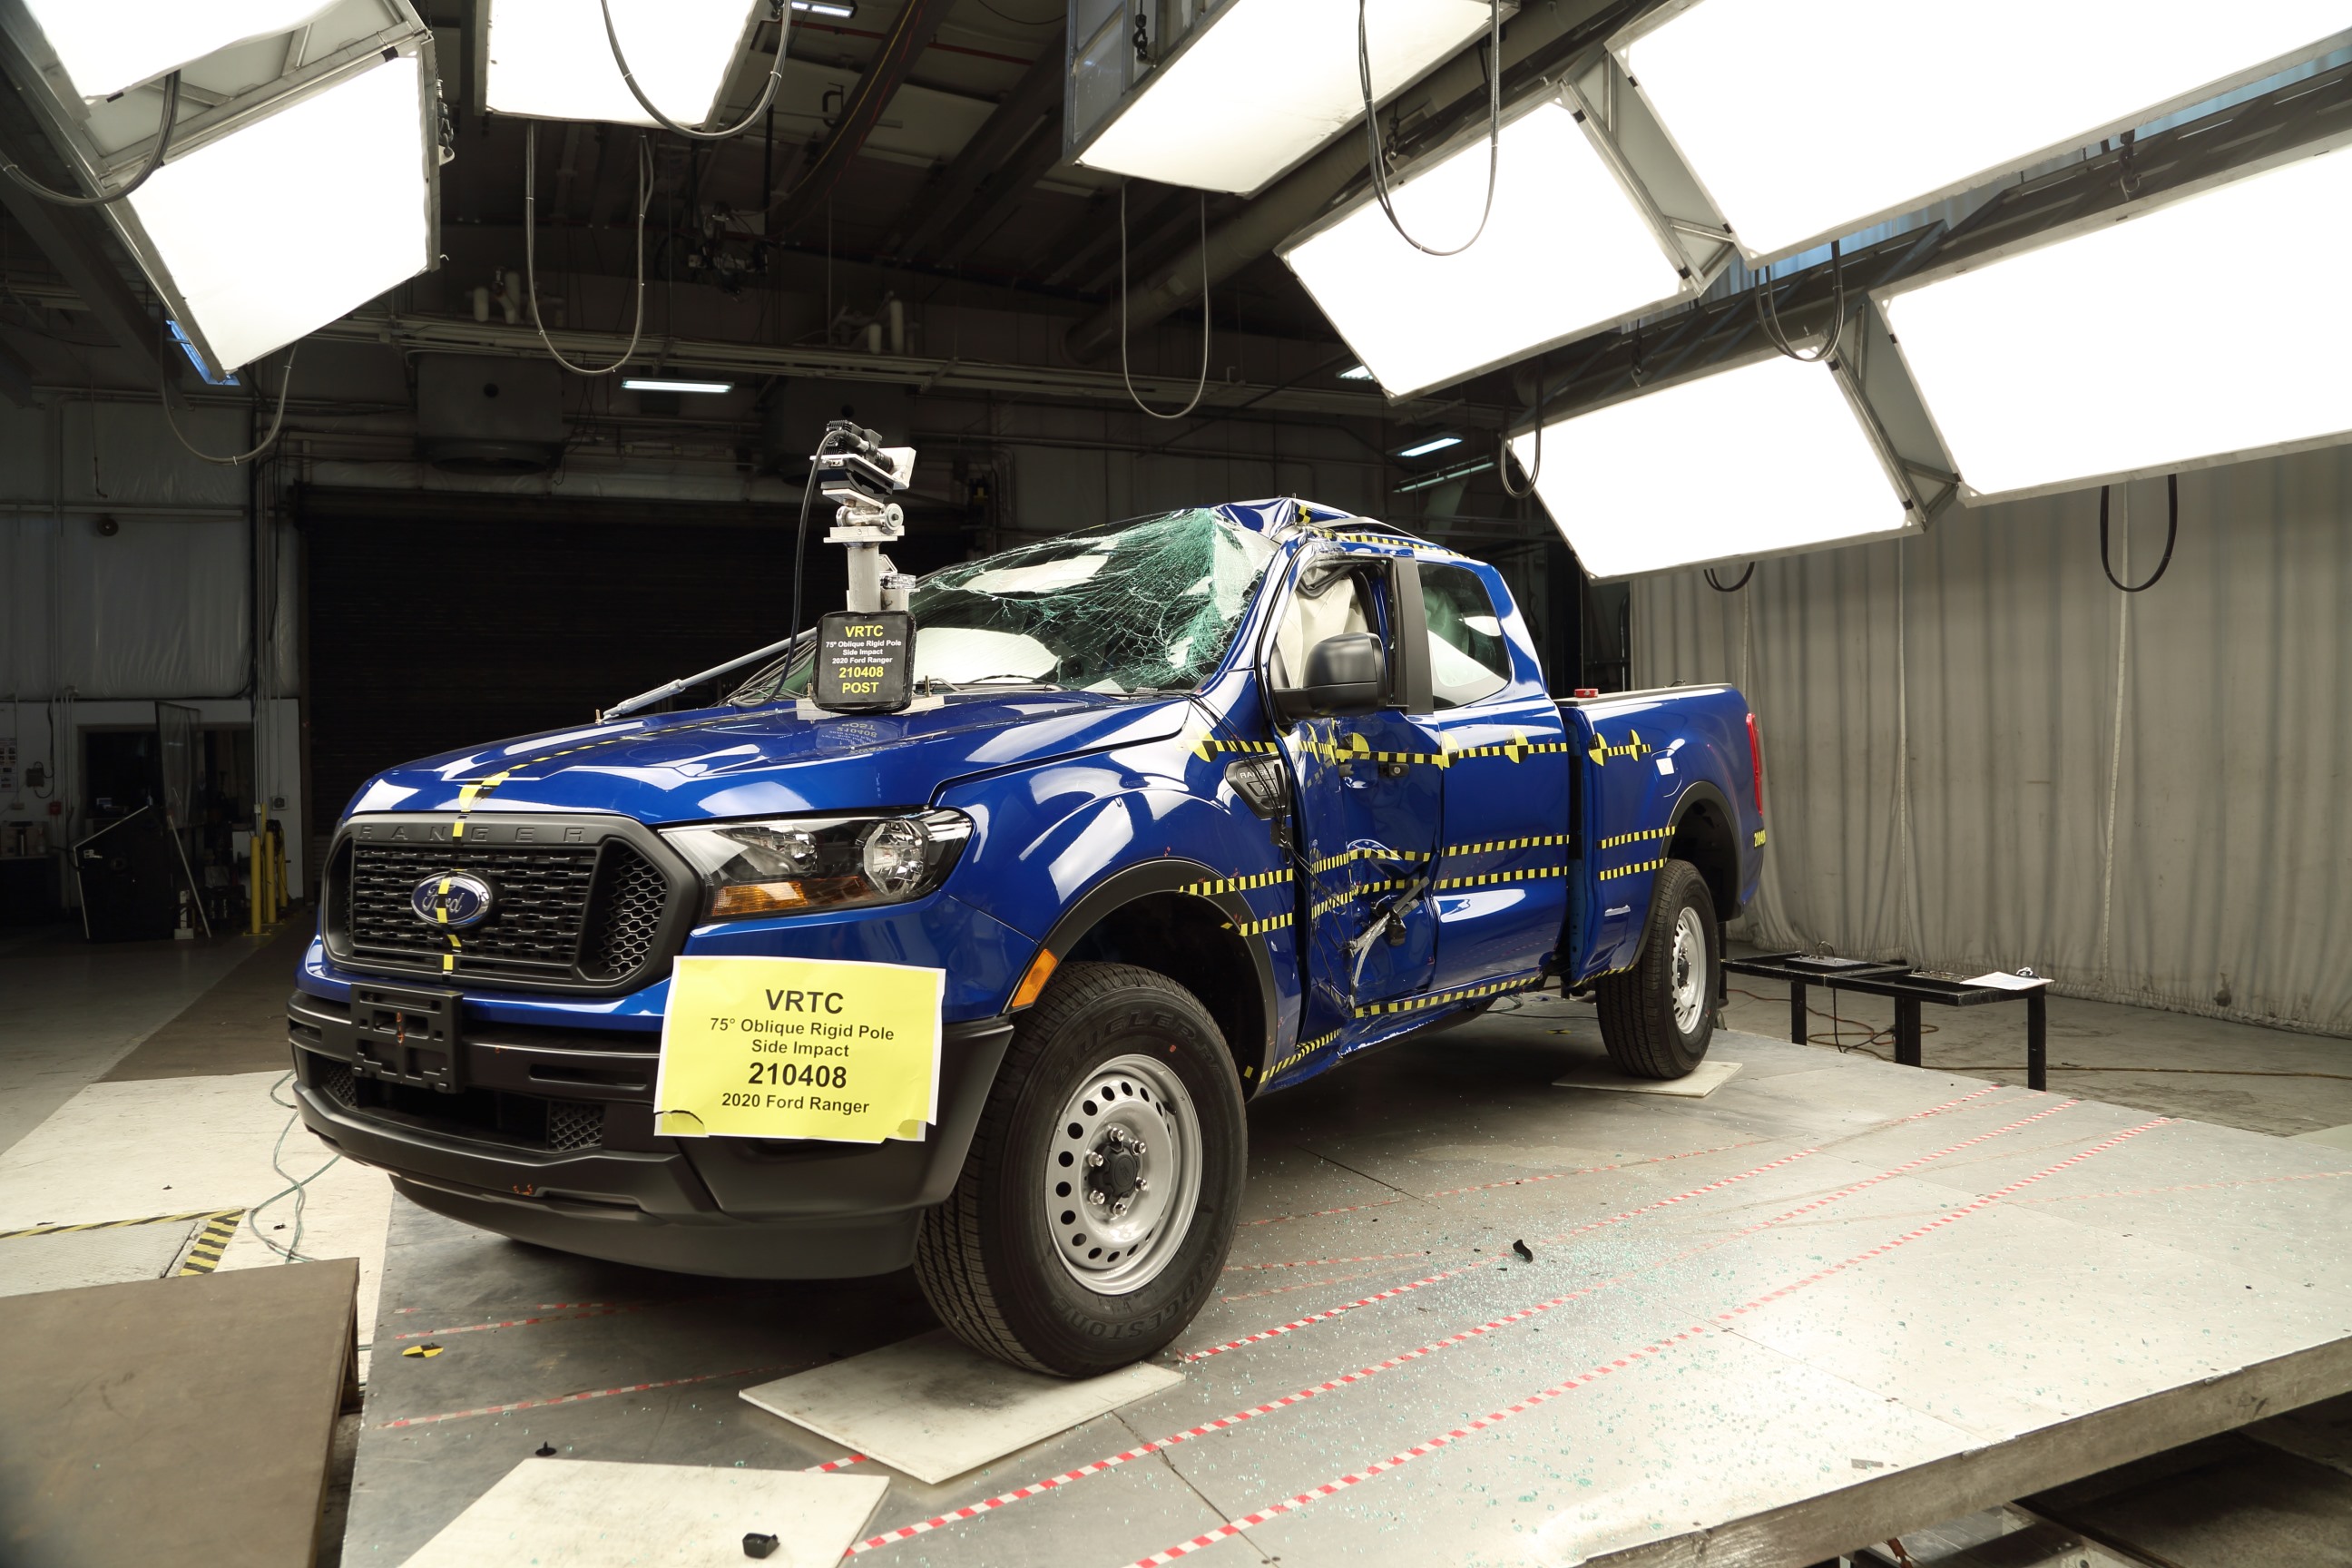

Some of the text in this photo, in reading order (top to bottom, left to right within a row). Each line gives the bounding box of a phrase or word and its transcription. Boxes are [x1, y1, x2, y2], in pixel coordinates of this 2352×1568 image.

[845, 625, 884, 637] VRTC
[866, 640, 885, 648] Rigid
[838, 666, 884, 679] 210408
[842, 682, 879, 694] POST
[358, 825, 585, 843] RANGER
[765, 988, 844, 1014] VRTC
[710, 1017, 895, 1041] 75° Oblique Rigid Pole
[751, 1039, 849, 1058] Side Impact
[1054, 1009, 1197, 1096] DUELER
[748, 1062, 848, 1089] 210408
[721, 1093, 870, 1115] 2020 Ford Ranger
